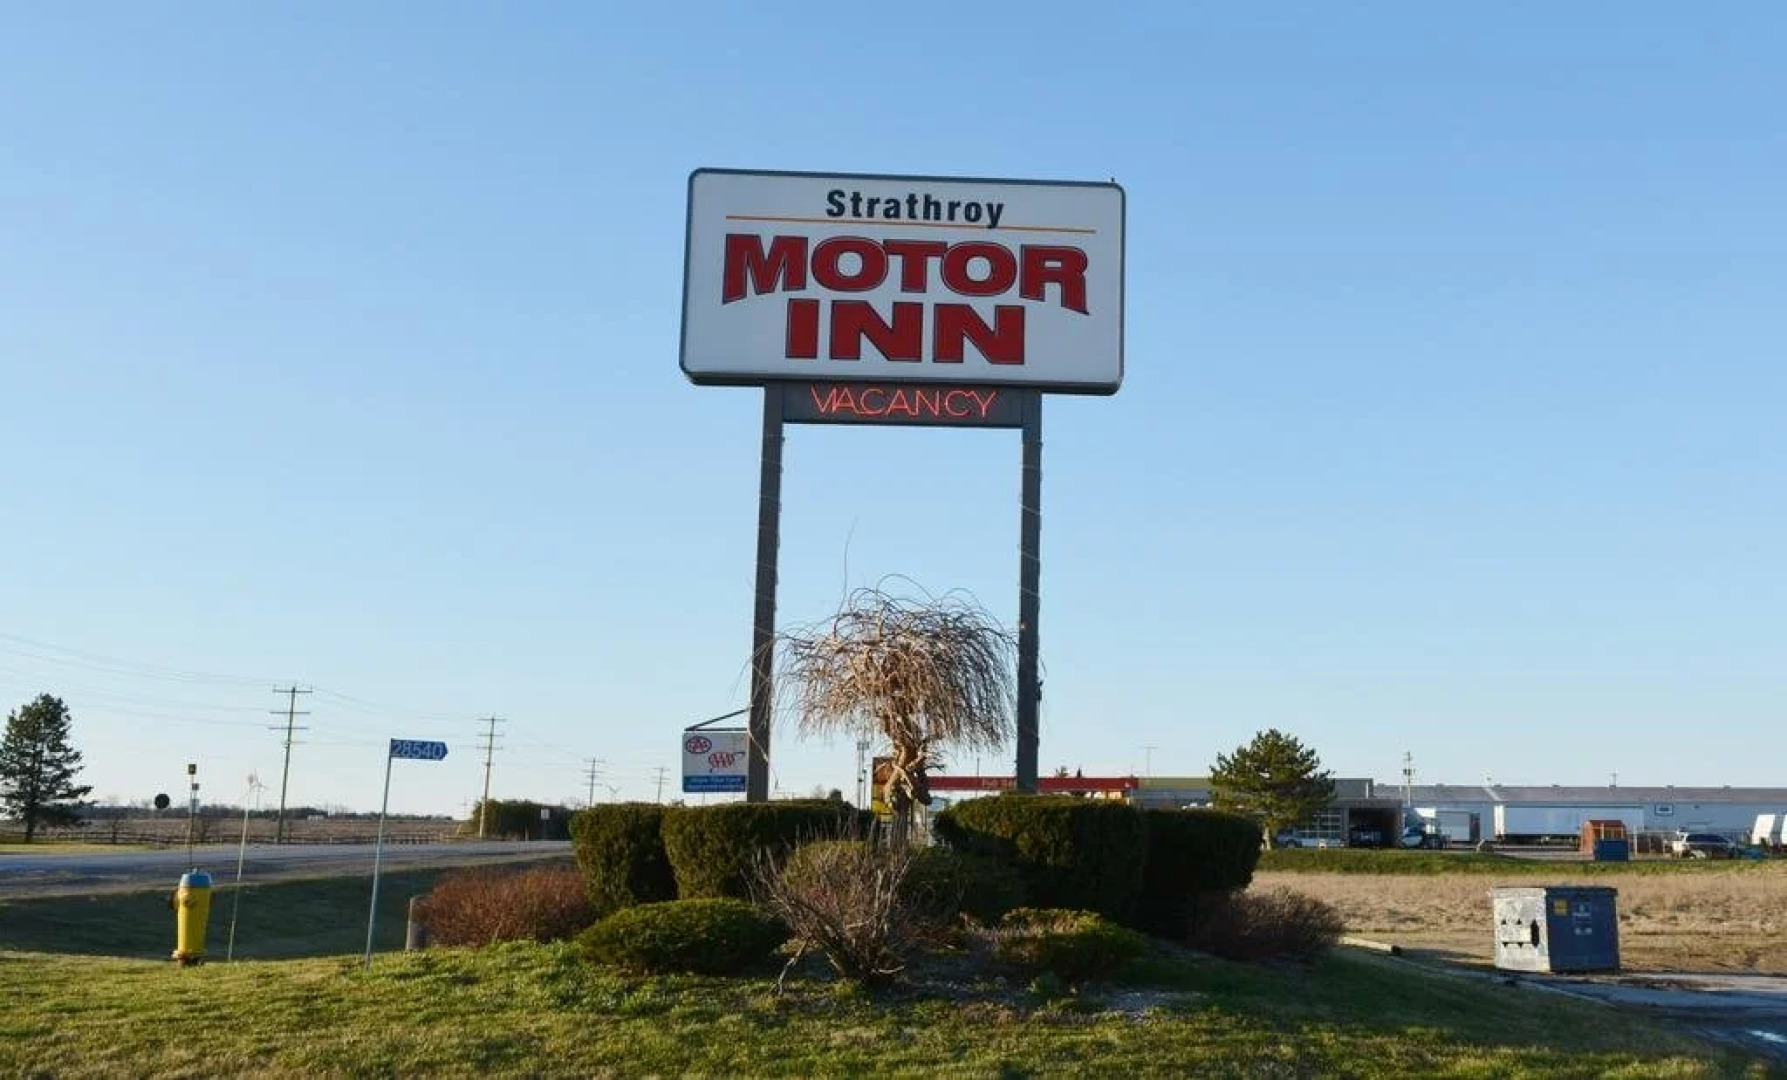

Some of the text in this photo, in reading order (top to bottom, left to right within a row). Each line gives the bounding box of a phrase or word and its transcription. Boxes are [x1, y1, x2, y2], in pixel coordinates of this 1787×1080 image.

[826, 189, 1004, 229] Strathroy
[722, 233, 1090, 316] MOTOR
[785, 298, 1025, 365] INN
[810, 386, 997, 417] VACANCY
[391, 741, 442, 757] 28540
